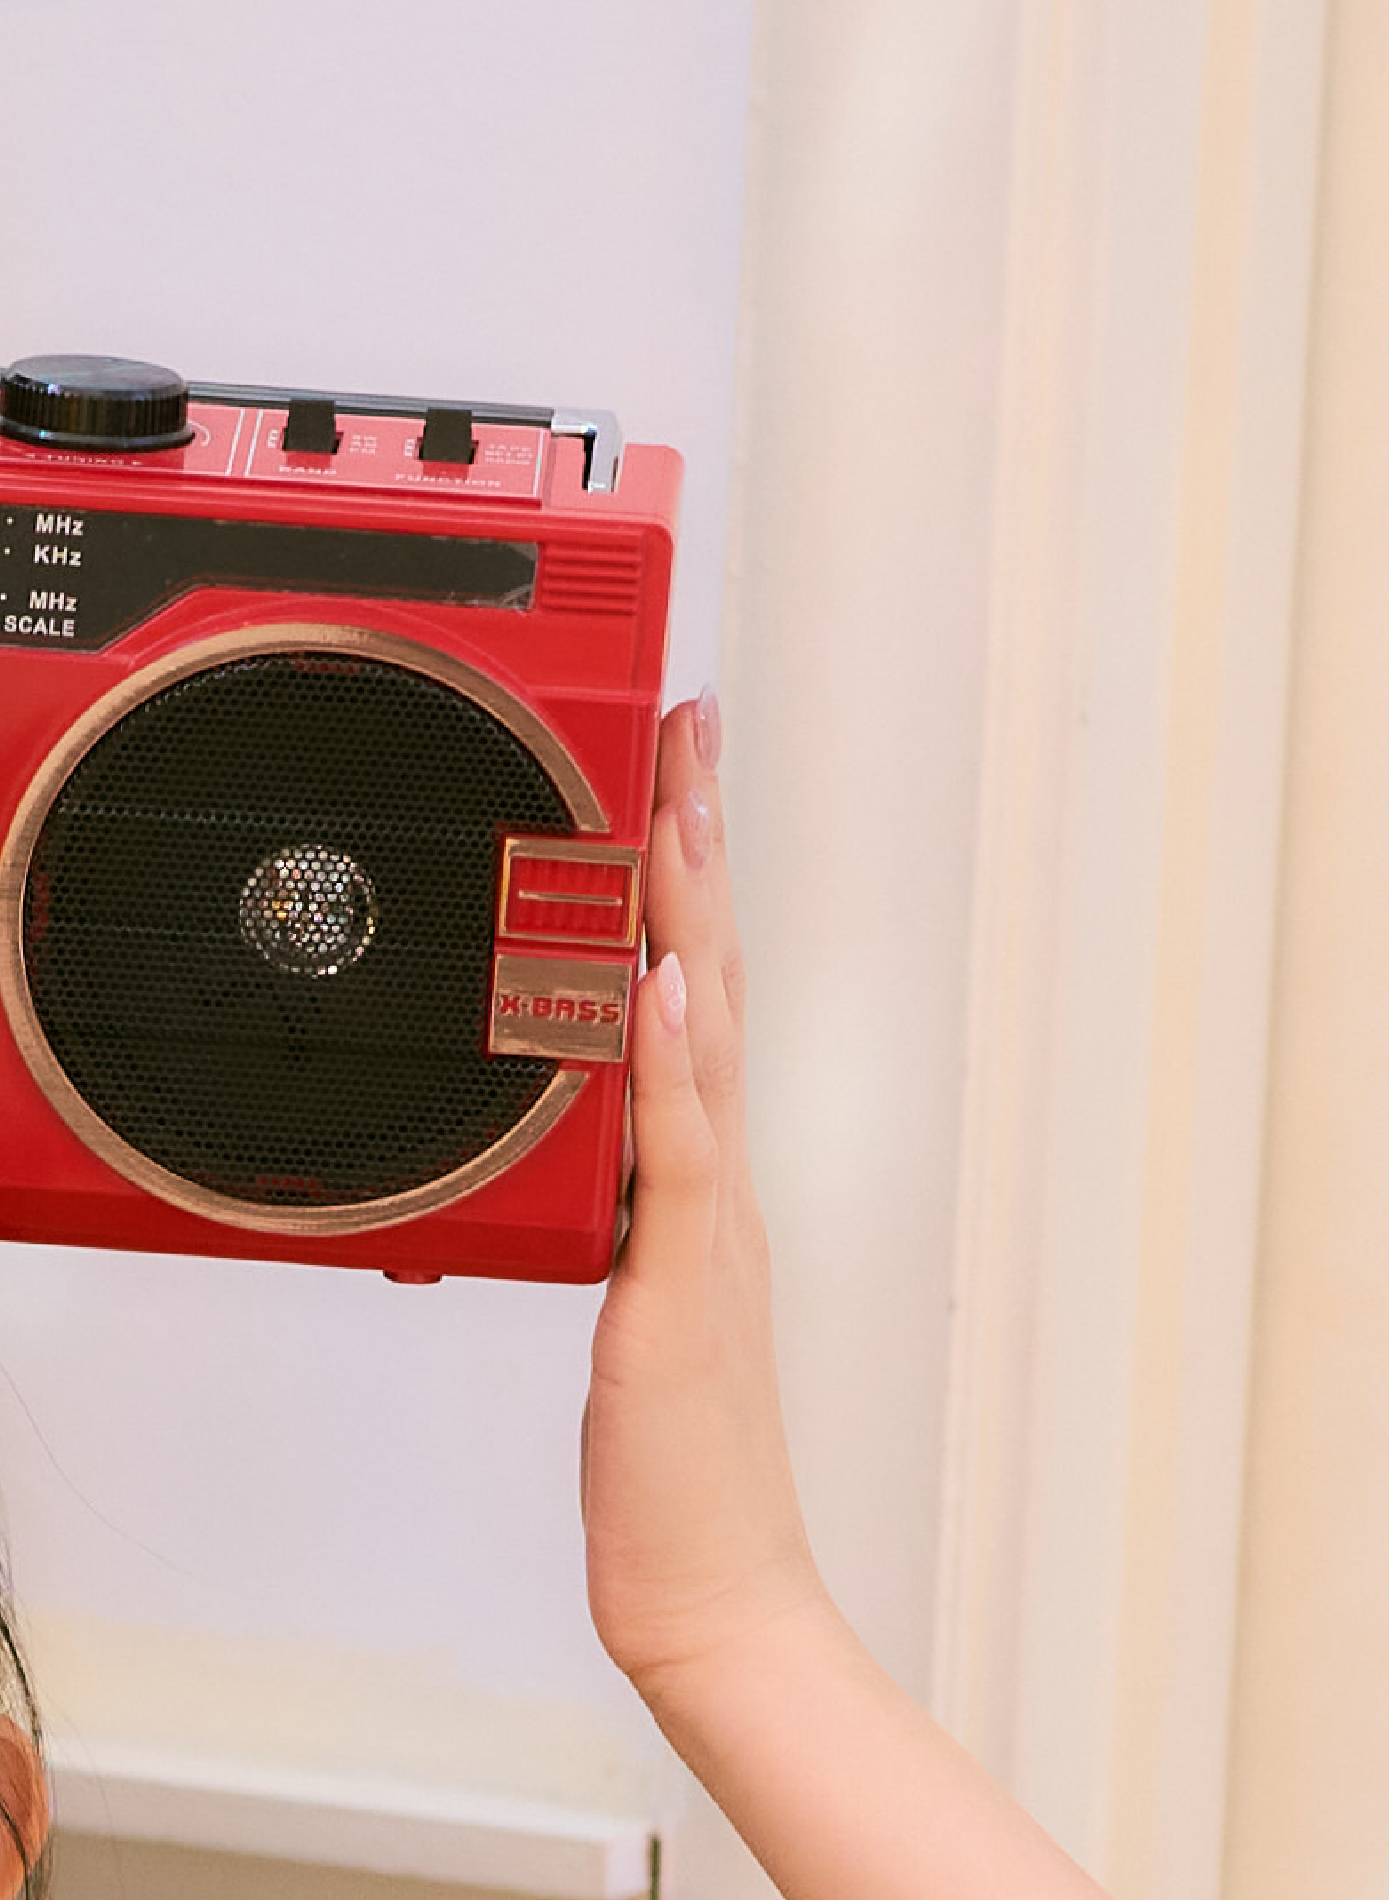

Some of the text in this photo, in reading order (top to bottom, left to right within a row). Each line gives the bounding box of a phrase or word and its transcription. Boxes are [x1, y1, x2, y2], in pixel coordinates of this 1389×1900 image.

[34, 512, 84, 536] MHz
[33, 543, 82, 568] KHz
[29, 590, 77, 613] MHz
[3, 614, 76, 638] SCALE
[498, 994, 621, 1024] X-BASS
